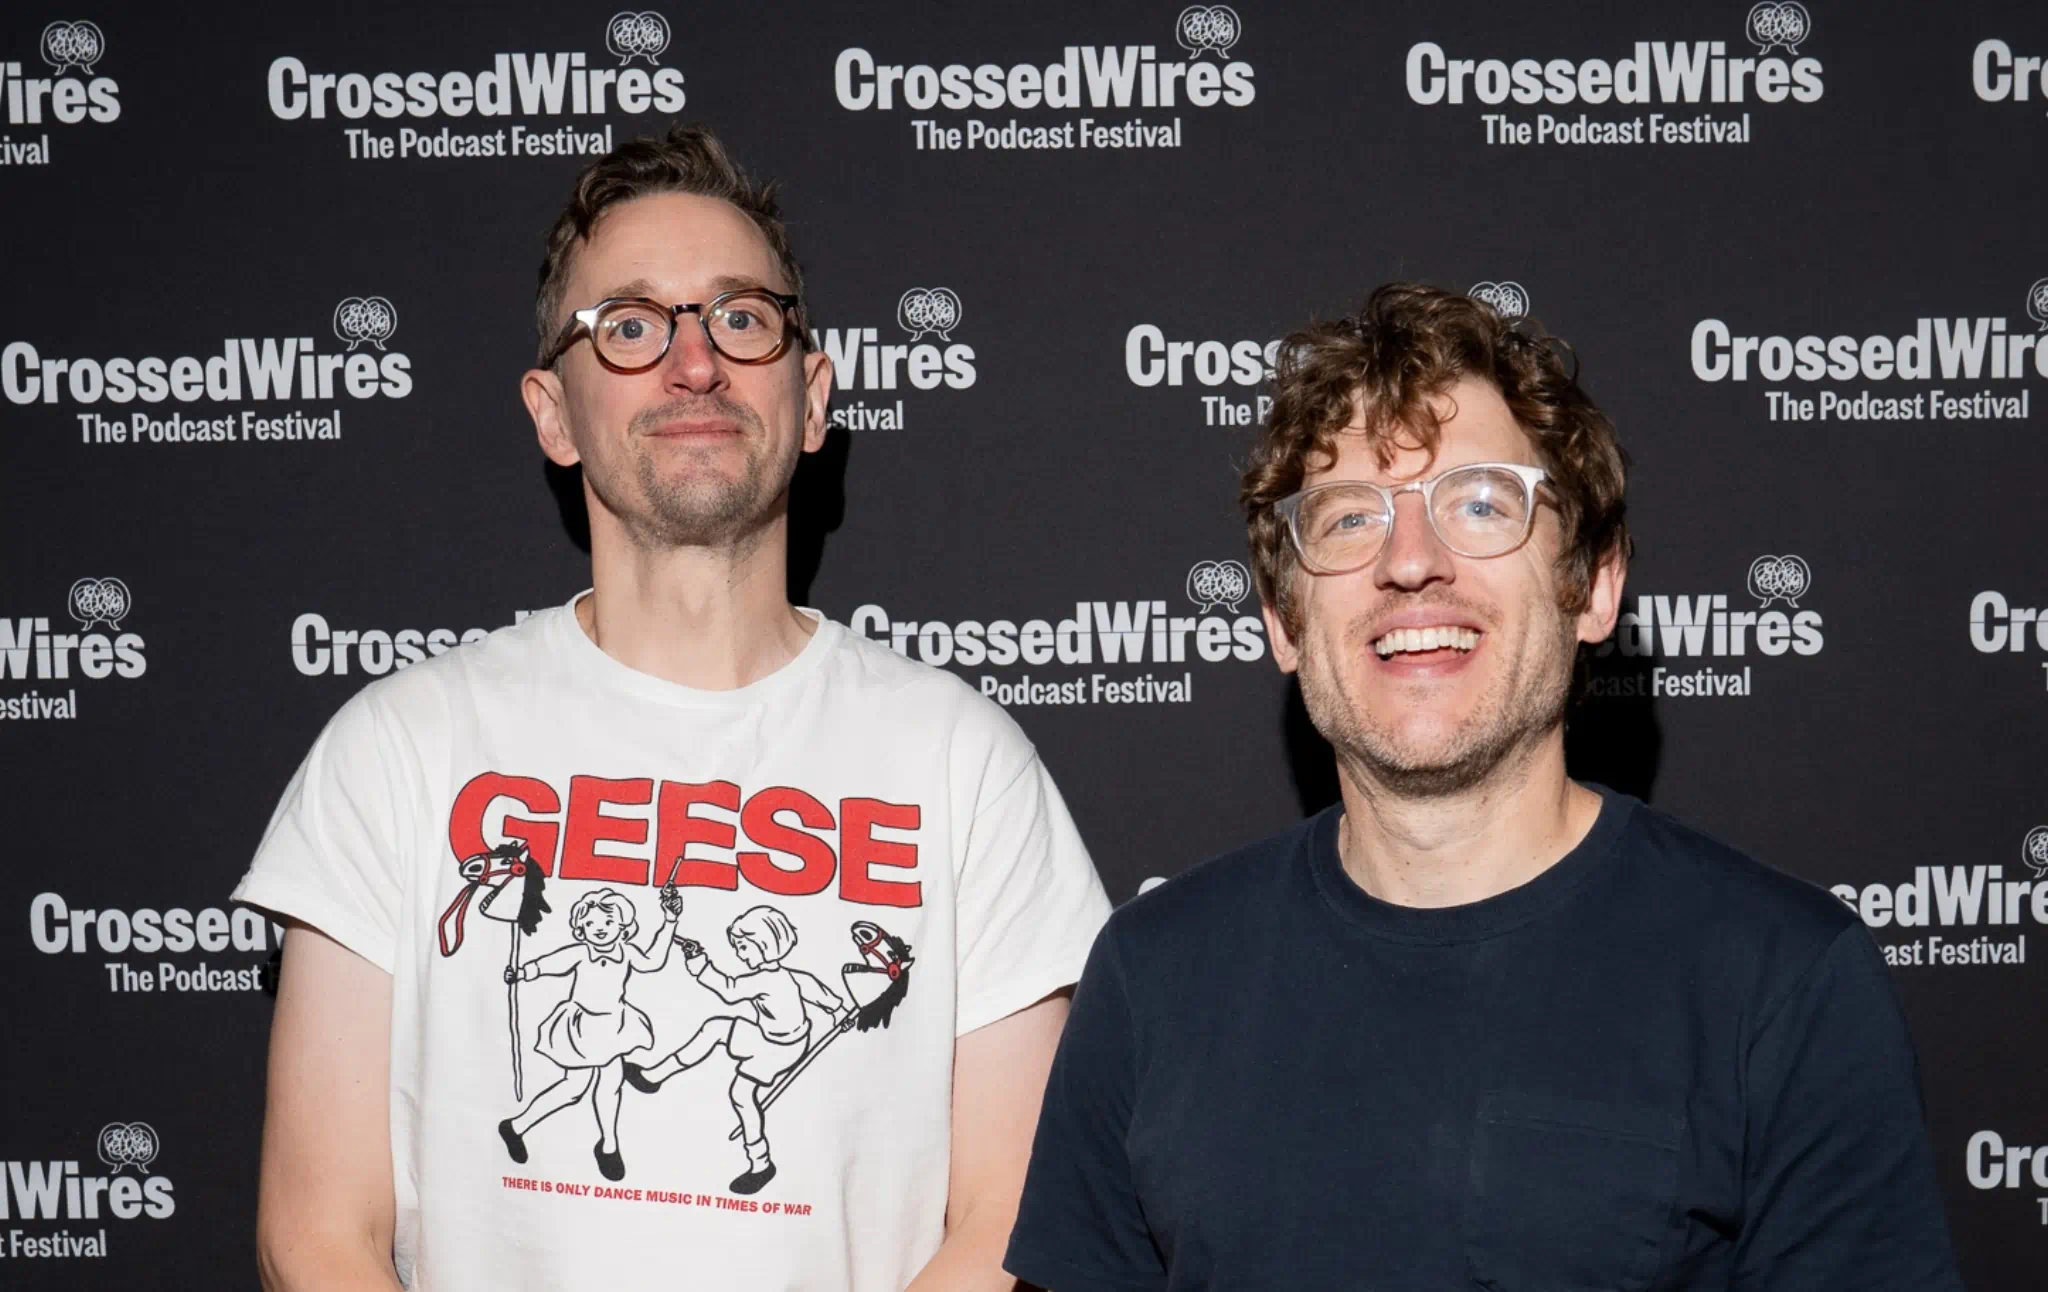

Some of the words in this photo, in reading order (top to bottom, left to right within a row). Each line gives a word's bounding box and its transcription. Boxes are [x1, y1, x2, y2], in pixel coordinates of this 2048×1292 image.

[268, 52, 686, 120] CrossedWires
[835, 46, 1256, 111] CrossedWires
[1406, 41, 1824, 106] CrossedWires
[1973, 38, 2048, 102] Cr
[0, 62, 121, 124] ires
[345, 128, 395, 160] The
[400, 127, 507, 158] Podcast
[512, 124, 613, 156] Festival
[911, 119, 961, 151] The
[967, 118, 1074, 150] Podcast
[1080, 117, 1181, 149] Festival
[1482, 114, 1532, 146] The
[1538, 114, 1645, 145] Podcast
[1650, 113, 1750, 144] Festival
[2, 338, 413, 405] CrossedWires
[1201, 395, 1252, 426] The
[1765, 391, 1815, 421] The
[1820, 390, 1925, 421] Podcast
[1931, 389, 2029, 420] Festival
[77, 413, 127, 443] The
[132, 412, 237, 443] Podcast
[242, 409, 341, 441] Festival
[981, 673, 1087, 706] Podcast
[1092, 672, 1192, 704] Festival
[1652, 666, 1752, 697] Festival
[449, 770, 923, 908] GEESE
[1929, 935, 2025, 966] Festival
[105, 962, 154, 993] The
[159, 962, 263, 992] Podcast
[0, 1160, 176, 1221] Wires
[502, 1176, 538, 1191] THERE
[541, 1181, 553, 1193] IS
[556, 1182, 591, 1197] ONLY
[594, 1186, 642, 1201] DANCE
[646, 1190, 693, 1205] MUSIC
[696, 1195, 711, 1207] IN
[715, 1196, 758, 1212] TIMES
[762, 1202, 781, 1214] OF
[784, 1203, 812, 1216] WAR
[11, 1229, 107, 1259] Festival
